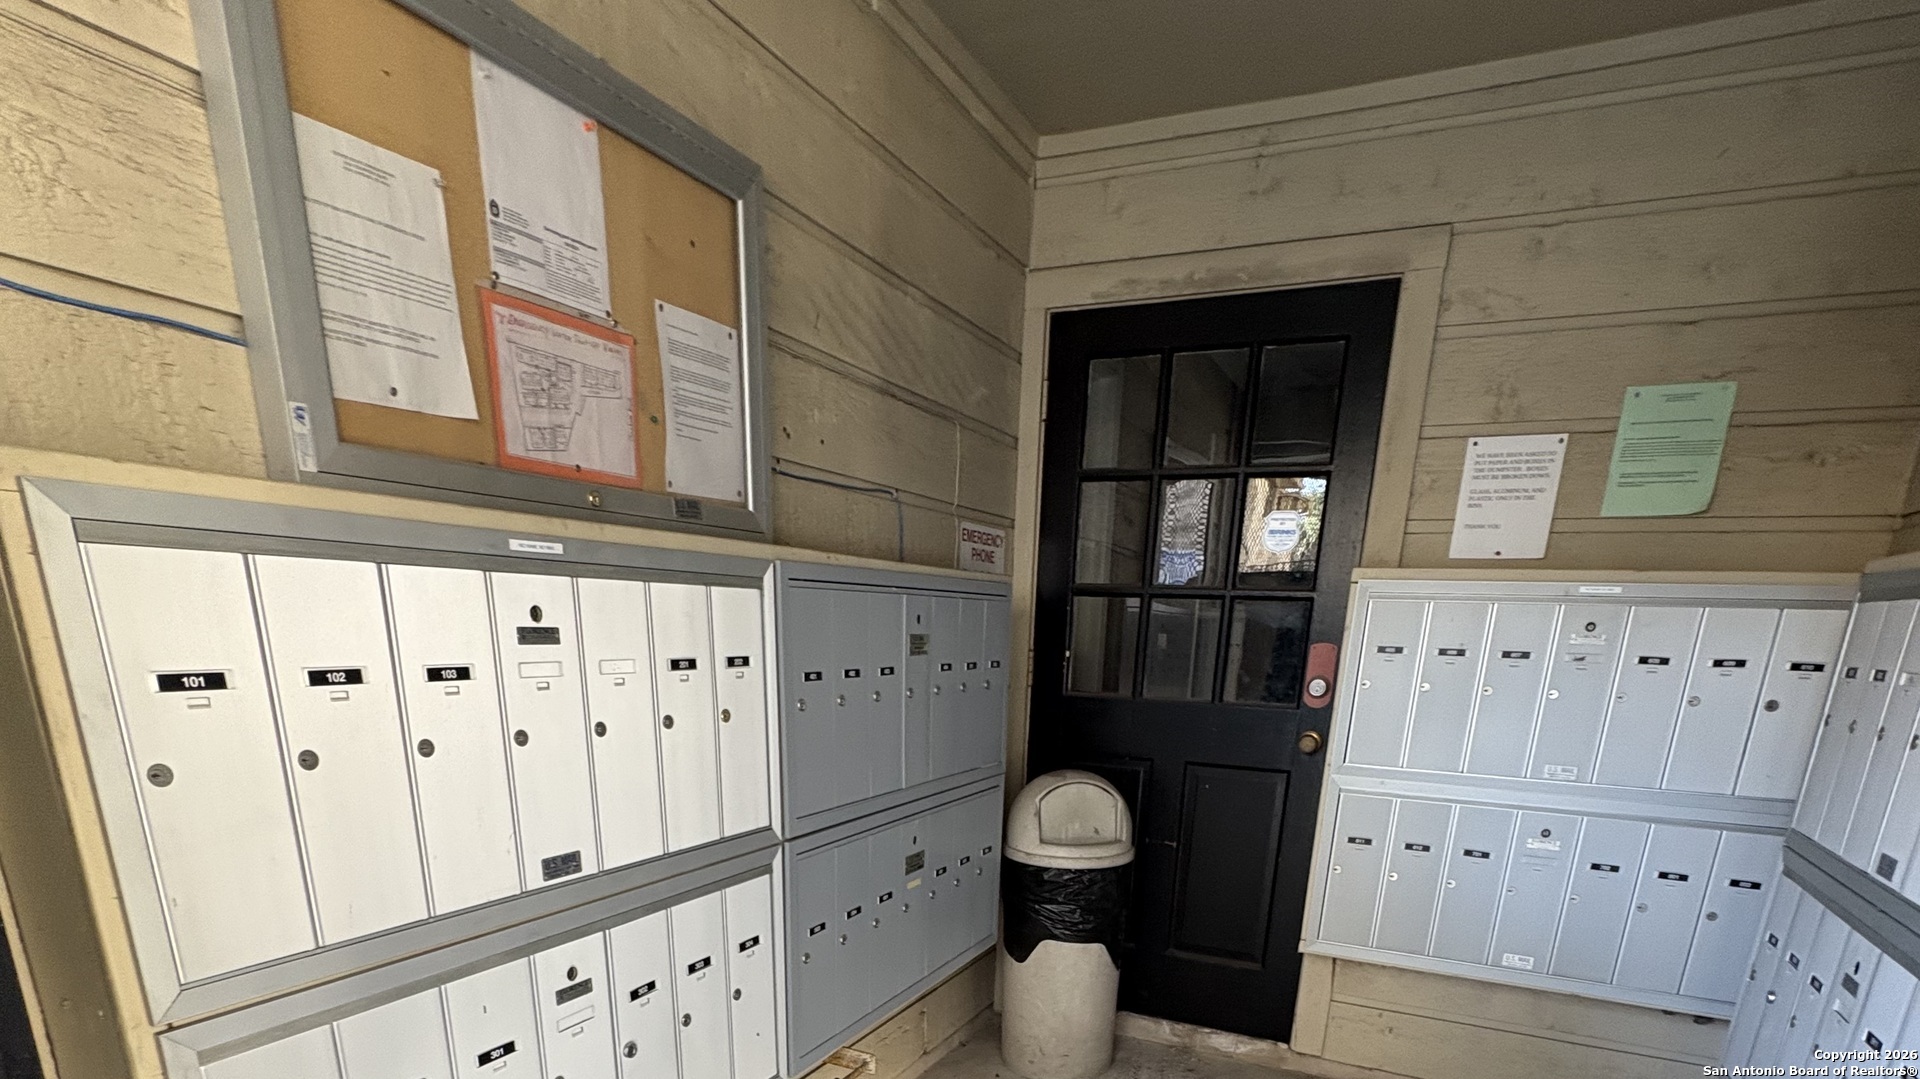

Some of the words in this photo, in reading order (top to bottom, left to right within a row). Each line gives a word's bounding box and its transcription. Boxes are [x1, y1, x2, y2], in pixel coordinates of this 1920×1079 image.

[962, 528, 1003, 548] EMERGENCY
[972, 547, 995, 564] PHONE
[678, 661, 689, 669] 201
[326, 672, 347, 683] 102
[440, 669, 458, 680] 103
[181, 675, 206, 688] 101
[637, 985, 649, 995] 302
[490, 1048, 504, 1060] 301
